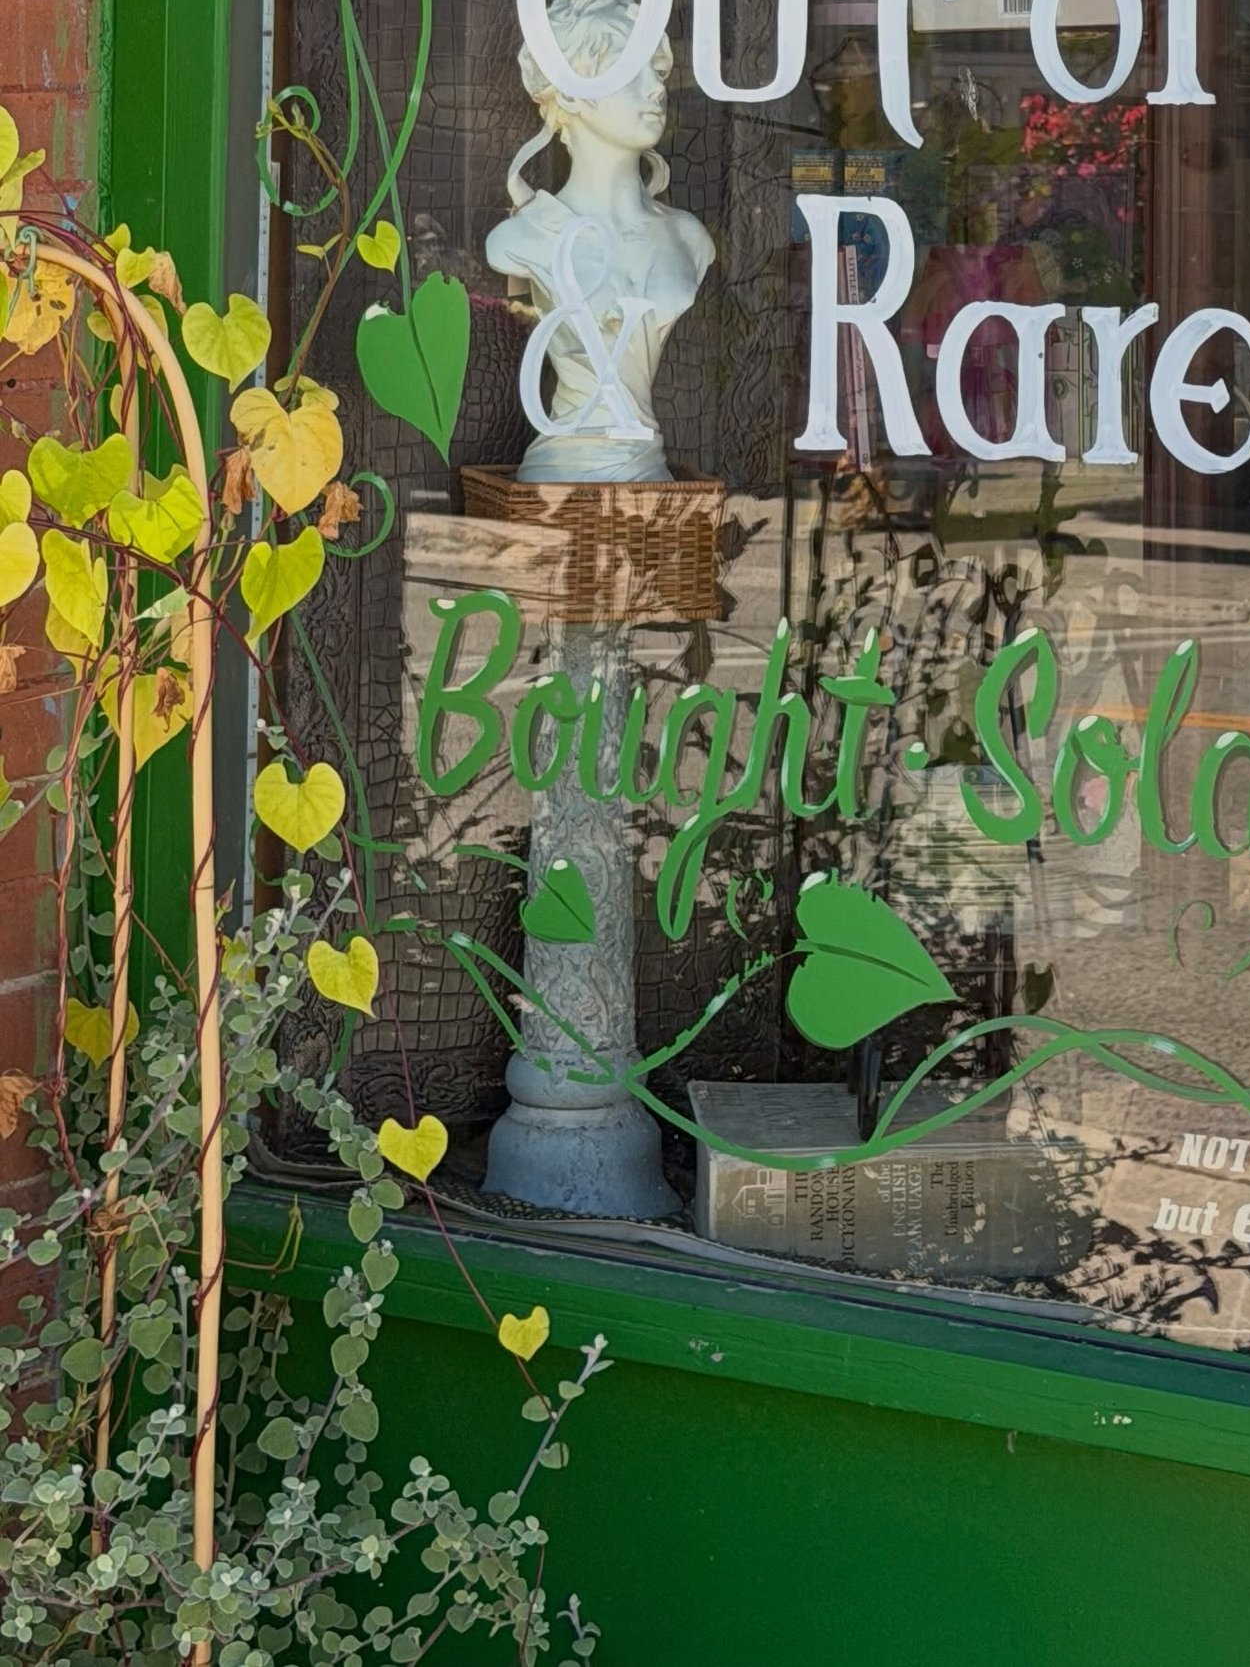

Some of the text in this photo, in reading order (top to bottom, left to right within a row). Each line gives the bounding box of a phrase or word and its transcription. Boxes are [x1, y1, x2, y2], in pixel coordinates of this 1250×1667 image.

[417, 590, 896, 943] Bought
[893, 1164, 907, 1237] ENGLISH
[930, 1161, 944, 1189] The
[945, 1161, 959, 1236] Unabridged
[961, 1161, 975, 1209] Edition
[1154, 1197, 1220, 1236] but
